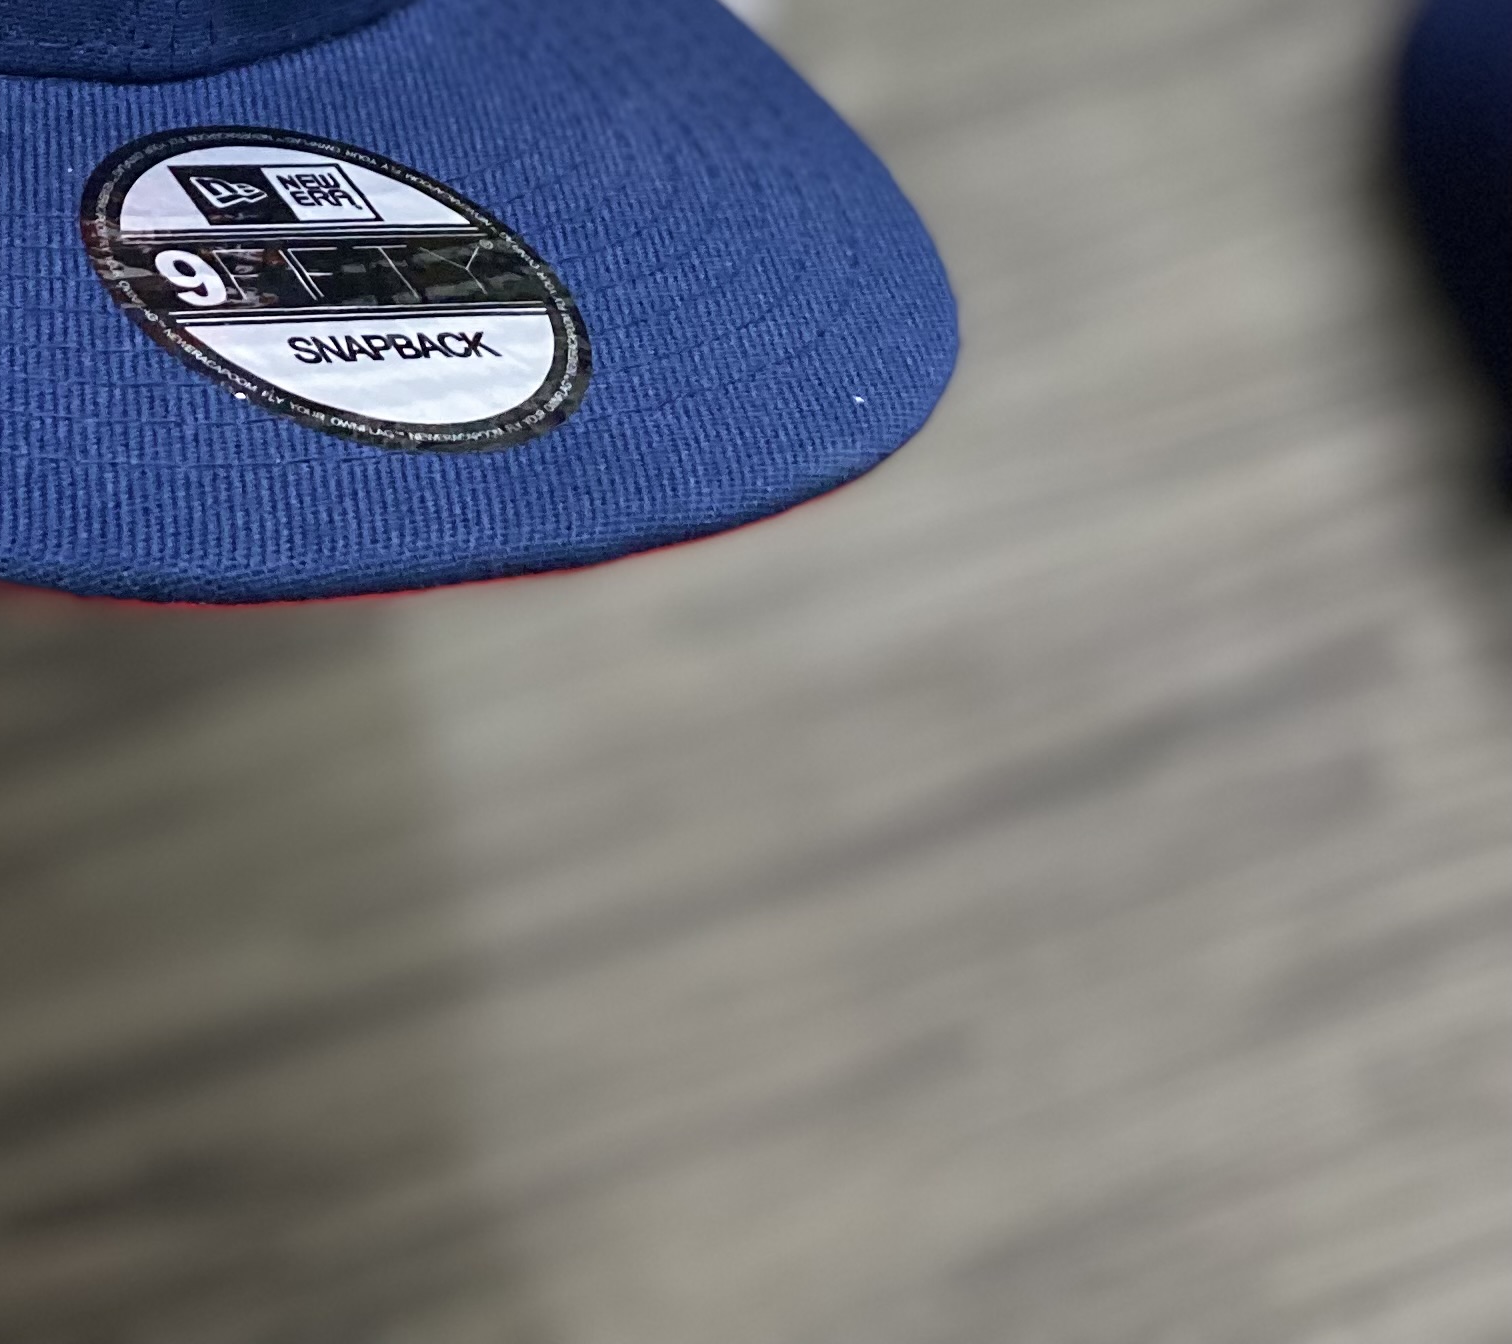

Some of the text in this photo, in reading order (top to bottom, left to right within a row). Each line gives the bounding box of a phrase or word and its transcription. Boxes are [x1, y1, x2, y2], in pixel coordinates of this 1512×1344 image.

[275, 171, 341, 191] NEW
[289, 188, 361, 210] ERA
[287, 331, 502, 365] SNAPBACK
